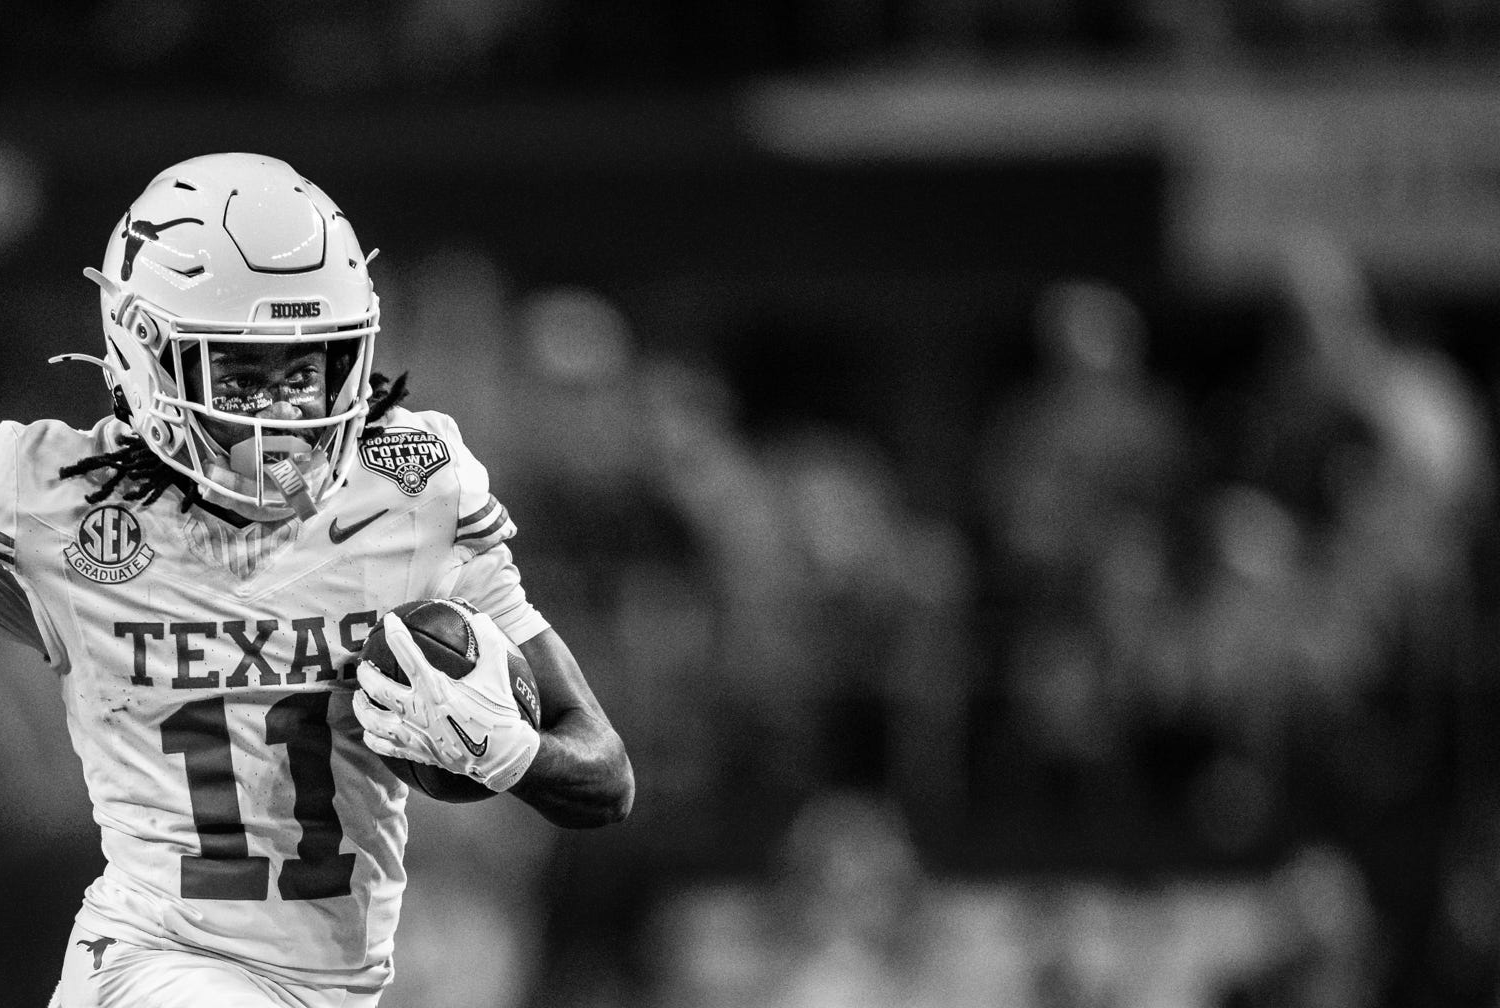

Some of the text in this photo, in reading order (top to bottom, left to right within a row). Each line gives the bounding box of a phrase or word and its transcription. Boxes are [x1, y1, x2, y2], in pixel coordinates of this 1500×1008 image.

[270, 301, 321, 319] HORNS
[366, 442, 444, 467] COTTON
[384, 454, 433, 470] BOWL
[82, 507, 138, 562] SEC
[74, 557, 144, 581] GRADUATE
[160, 691, 357, 901] 11
